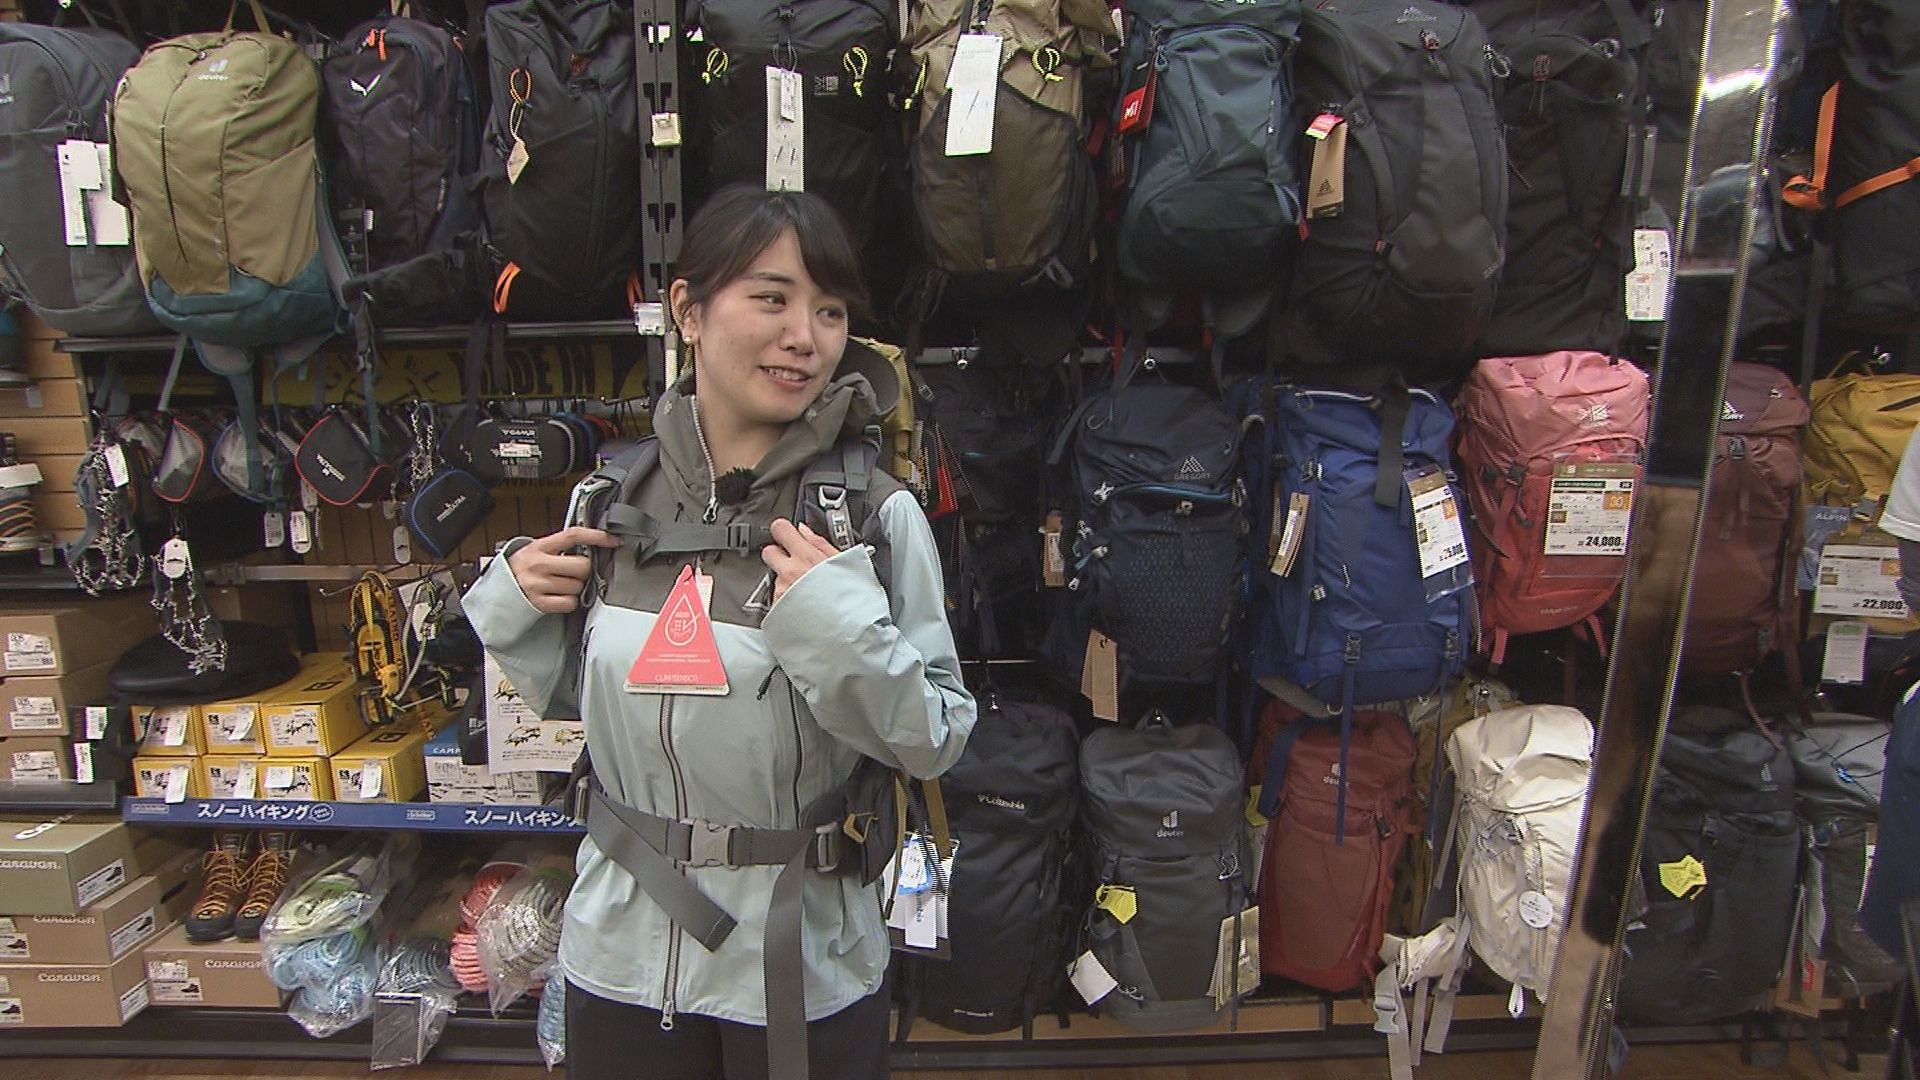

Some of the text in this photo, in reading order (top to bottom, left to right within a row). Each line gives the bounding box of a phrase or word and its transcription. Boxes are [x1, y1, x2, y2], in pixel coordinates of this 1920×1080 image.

[197, 803, 309, 821] スノーハイキング
